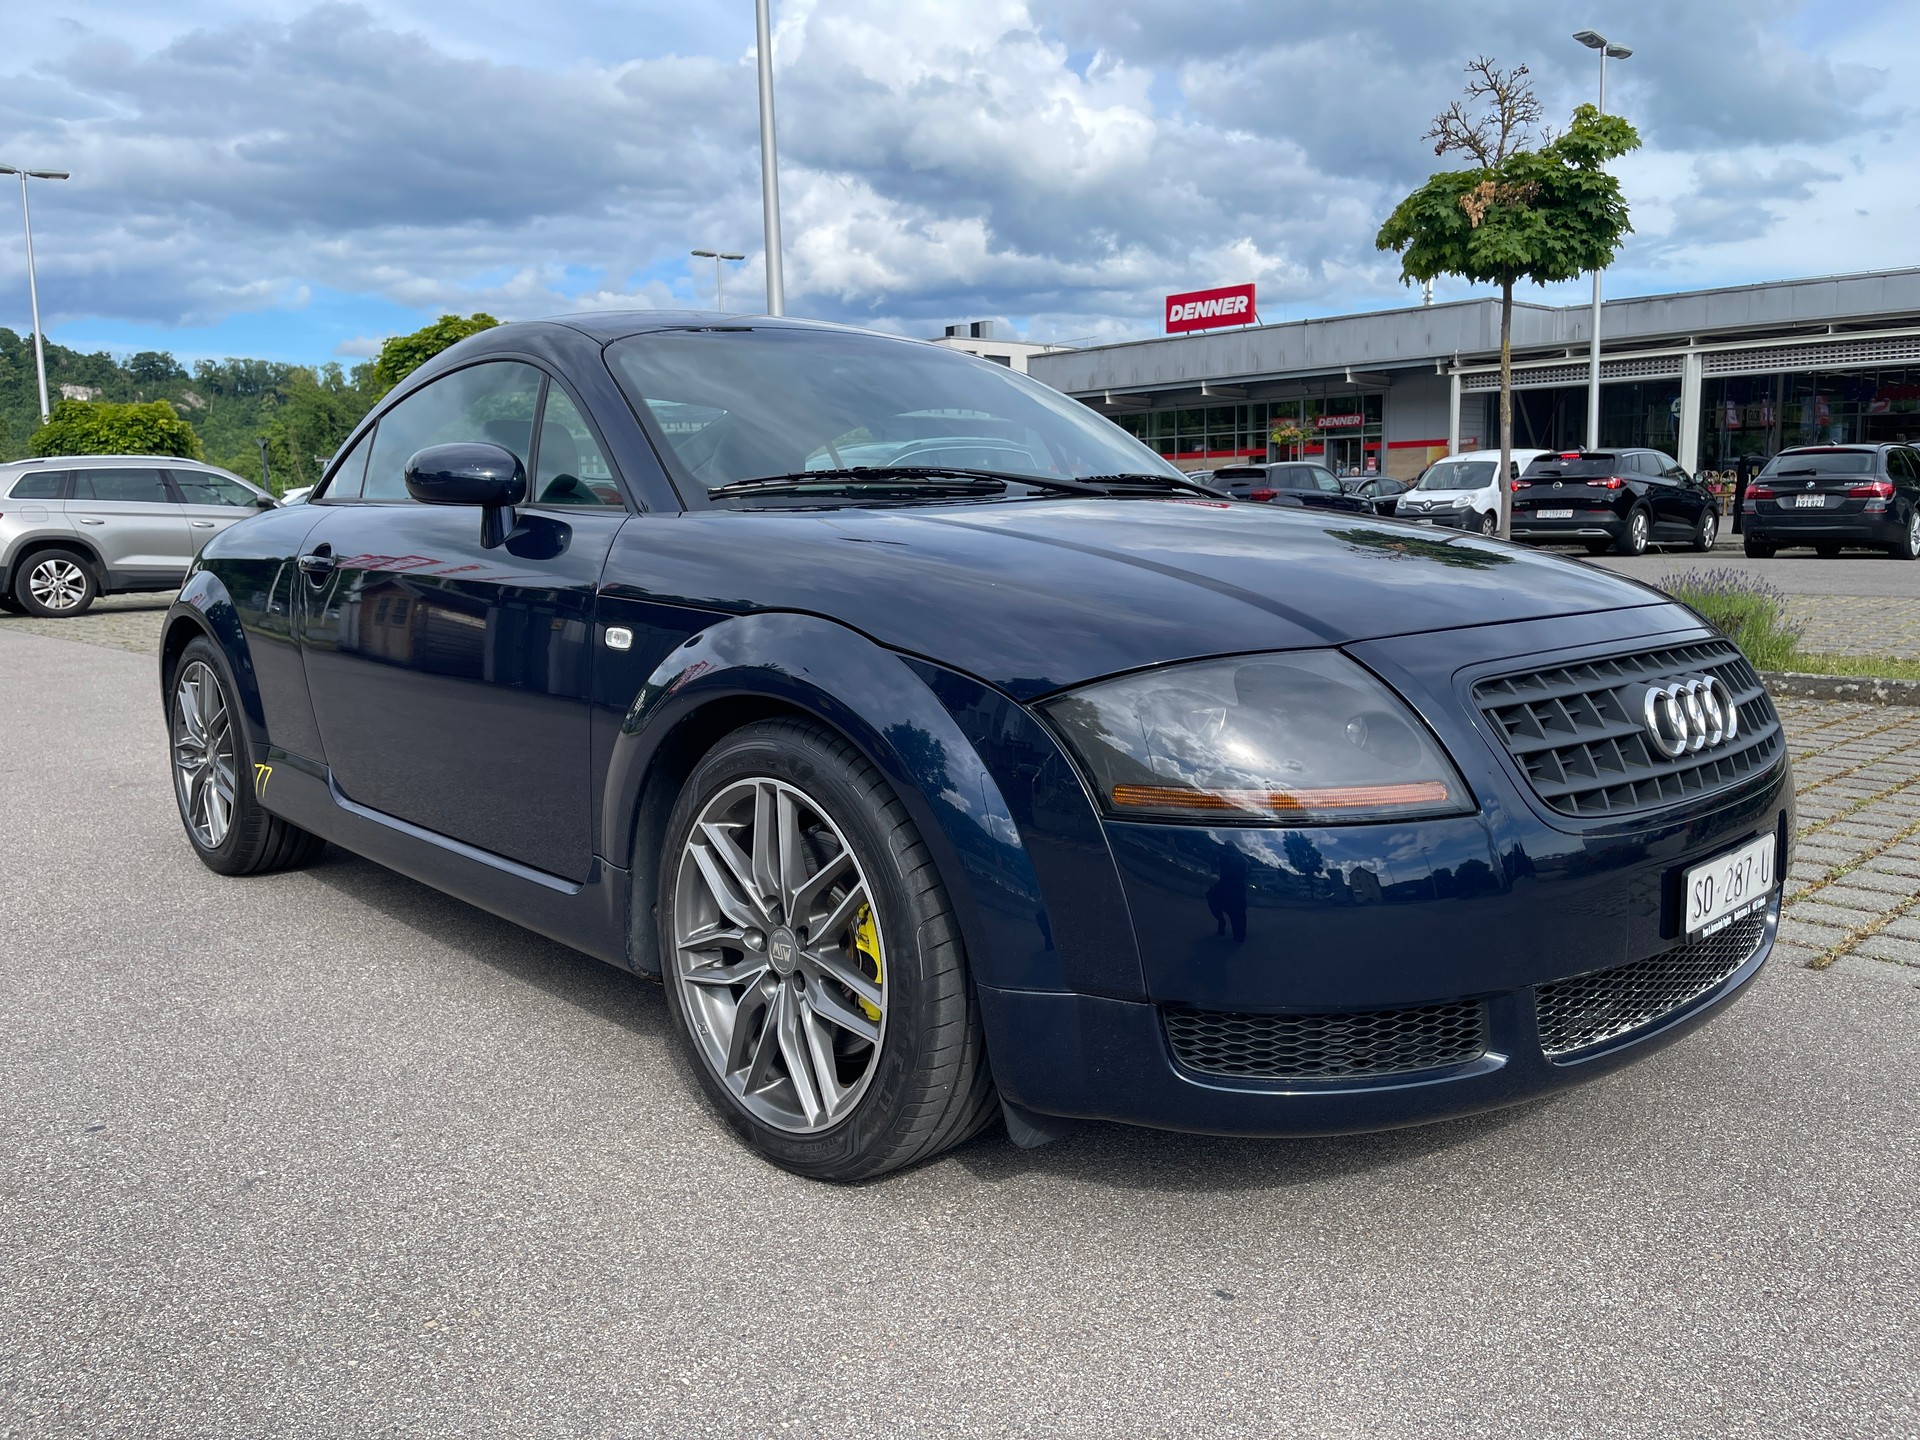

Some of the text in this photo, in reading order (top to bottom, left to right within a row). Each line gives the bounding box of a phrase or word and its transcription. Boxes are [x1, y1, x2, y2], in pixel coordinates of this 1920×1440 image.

[1168, 295, 1249, 323] DENNER
[1317, 415, 1361, 428] DENNER
[254, 763, 273, 801] 77
[772, 941, 792, 962] MSW
